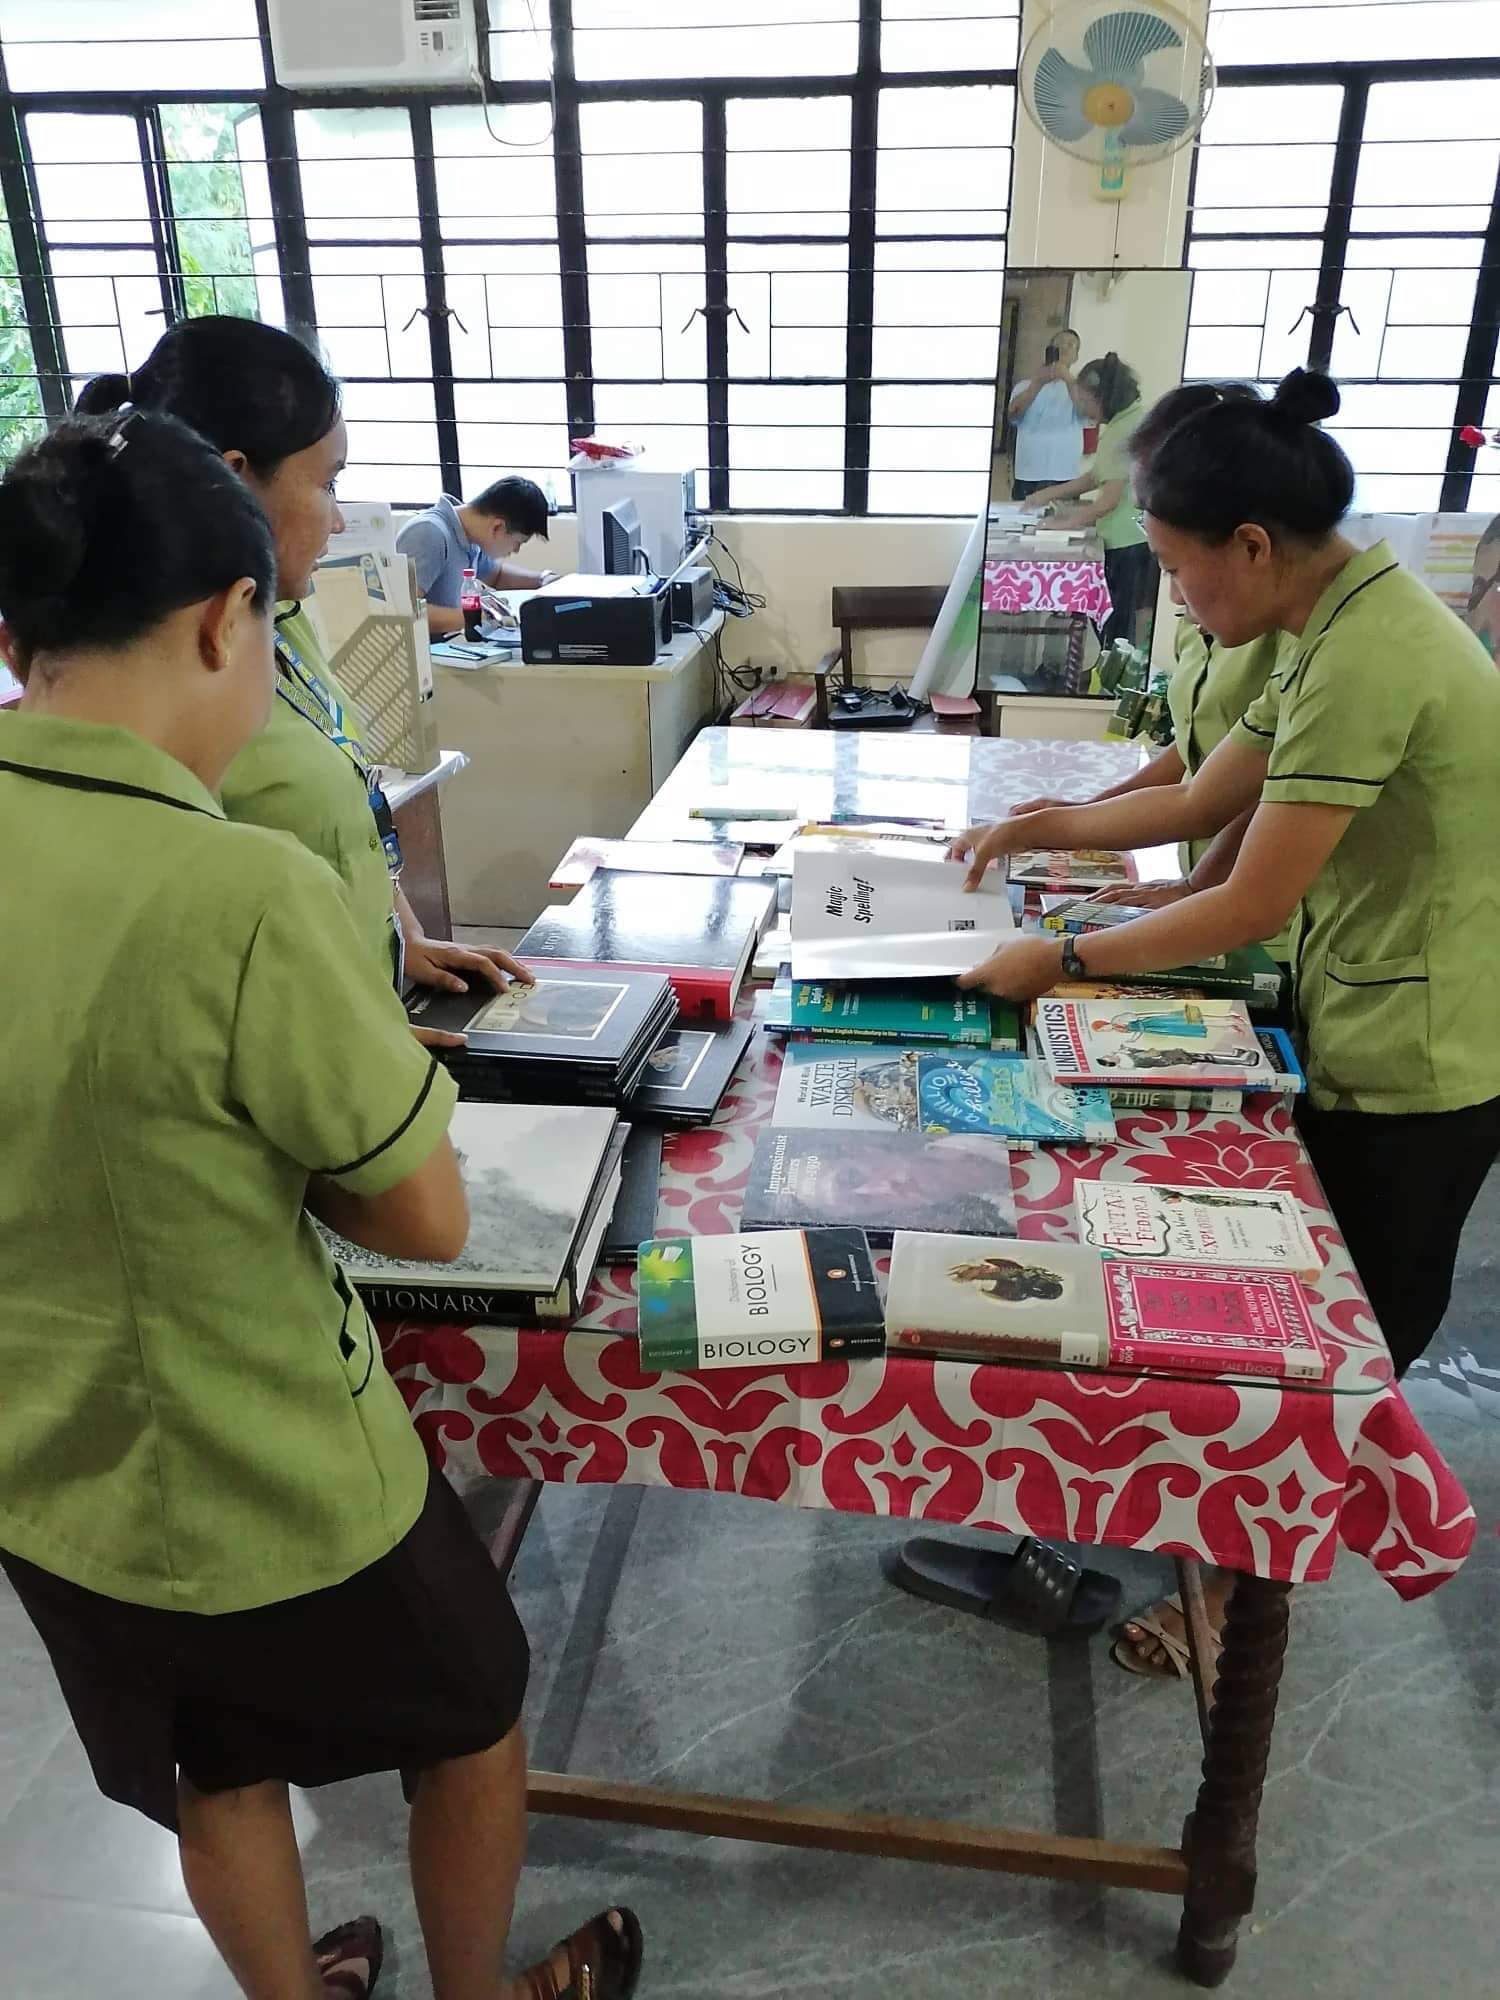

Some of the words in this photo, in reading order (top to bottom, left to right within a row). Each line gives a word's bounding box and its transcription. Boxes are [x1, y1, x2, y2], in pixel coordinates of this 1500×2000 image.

[826, 886, 848, 917] Magic
[853, 877, 874, 923] Spelling!
[1043, 1003, 1078, 1073] LINGUISTICS
[810, 1063, 835, 1107] WASTE
[832, 1057, 857, 1117] DISPOSAL
[927, 1074, 963, 1118] MILLION
[1124, 1090, 1161, 1107] TIDE
[763, 1134, 788, 1194] Impressionist
[1103, 1186, 1143, 1247] FINTAN
[1132, 1194, 1157, 1242] FEDORA
[1194, 1206, 1218, 1255] EXPLORER
[740, 1244, 769, 1316] BIOLOGY
[704, 1337, 812, 1359] BIOLOGY
